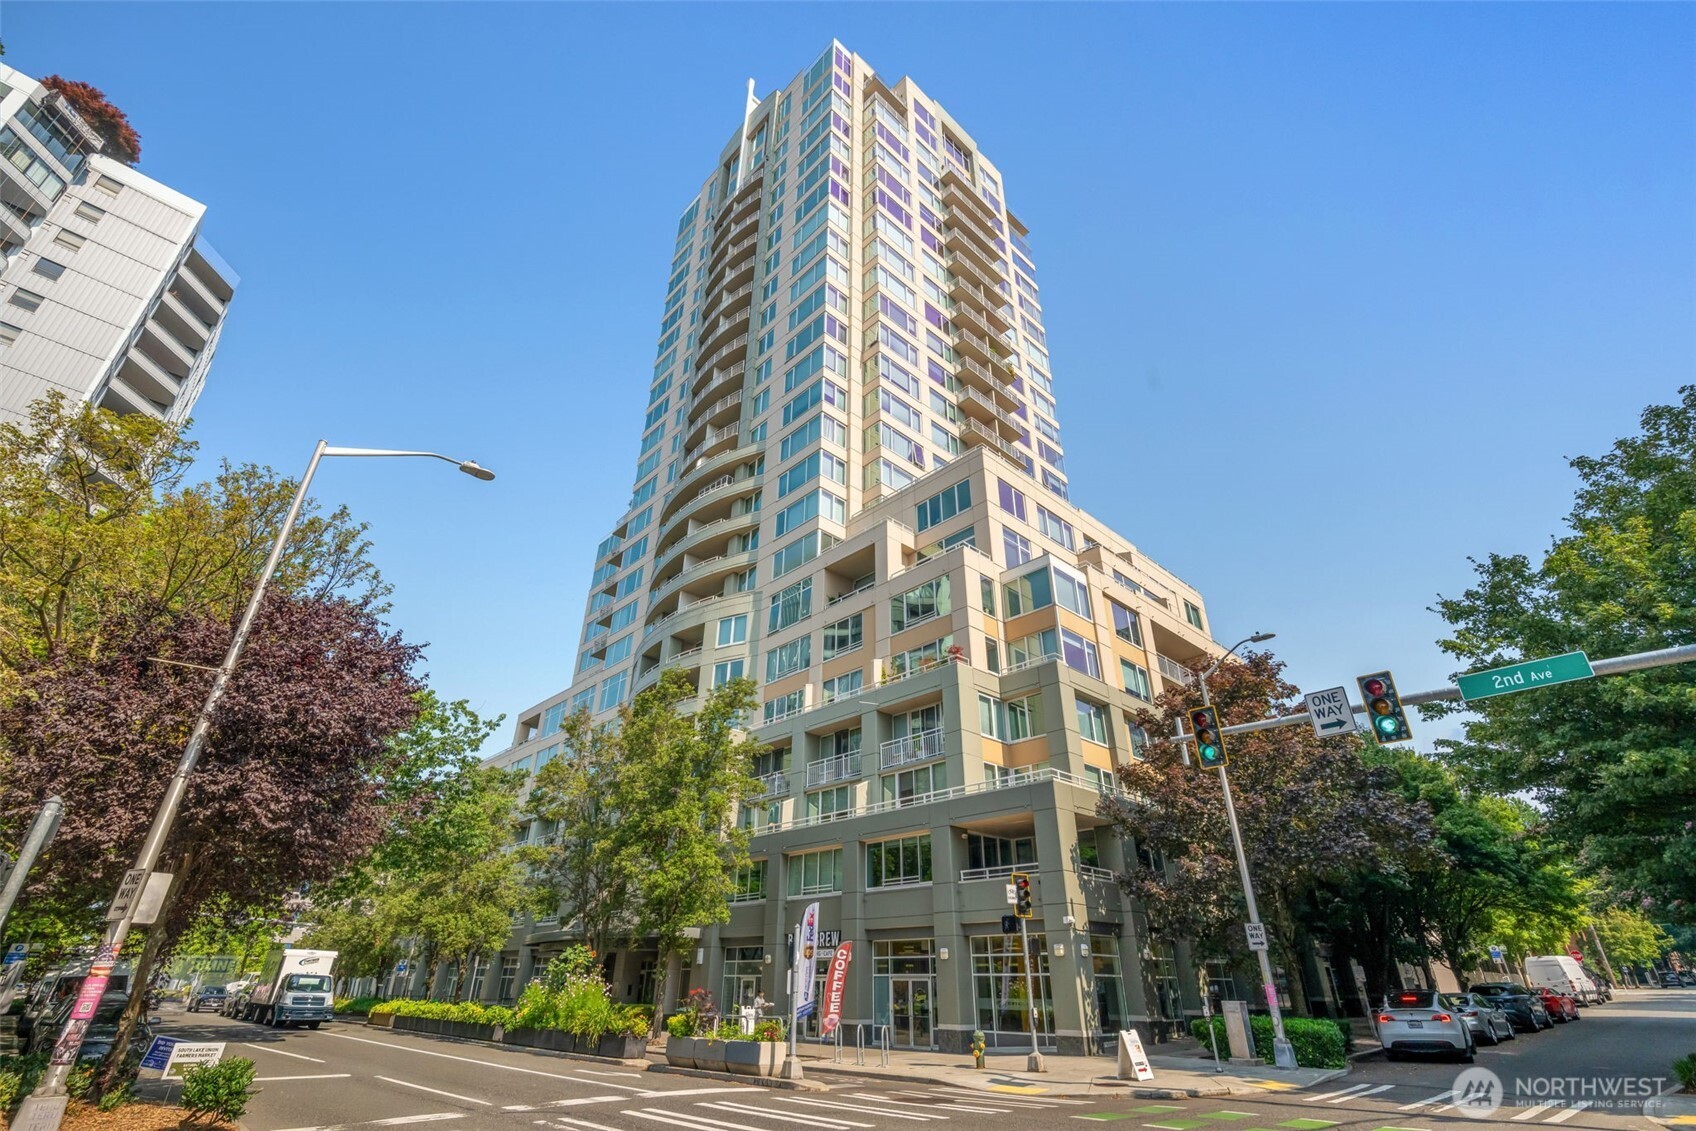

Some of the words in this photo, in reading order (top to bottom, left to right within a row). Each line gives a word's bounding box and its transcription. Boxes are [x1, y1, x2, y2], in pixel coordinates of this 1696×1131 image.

[1492, 671, 1524, 689] 2nd
[1530, 670, 1553, 681] Ave
[1312, 691, 1341, 707] ONE
[1314, 703, 1343, 719] WAY
[124, 873, 142, 885] ONE
[118, 887, 137, 899] WAY
[807, 912, 815, 942] FedEx
[817, 931, 840, 947] REW
[829, 949, 848, 1013] COFFEE
